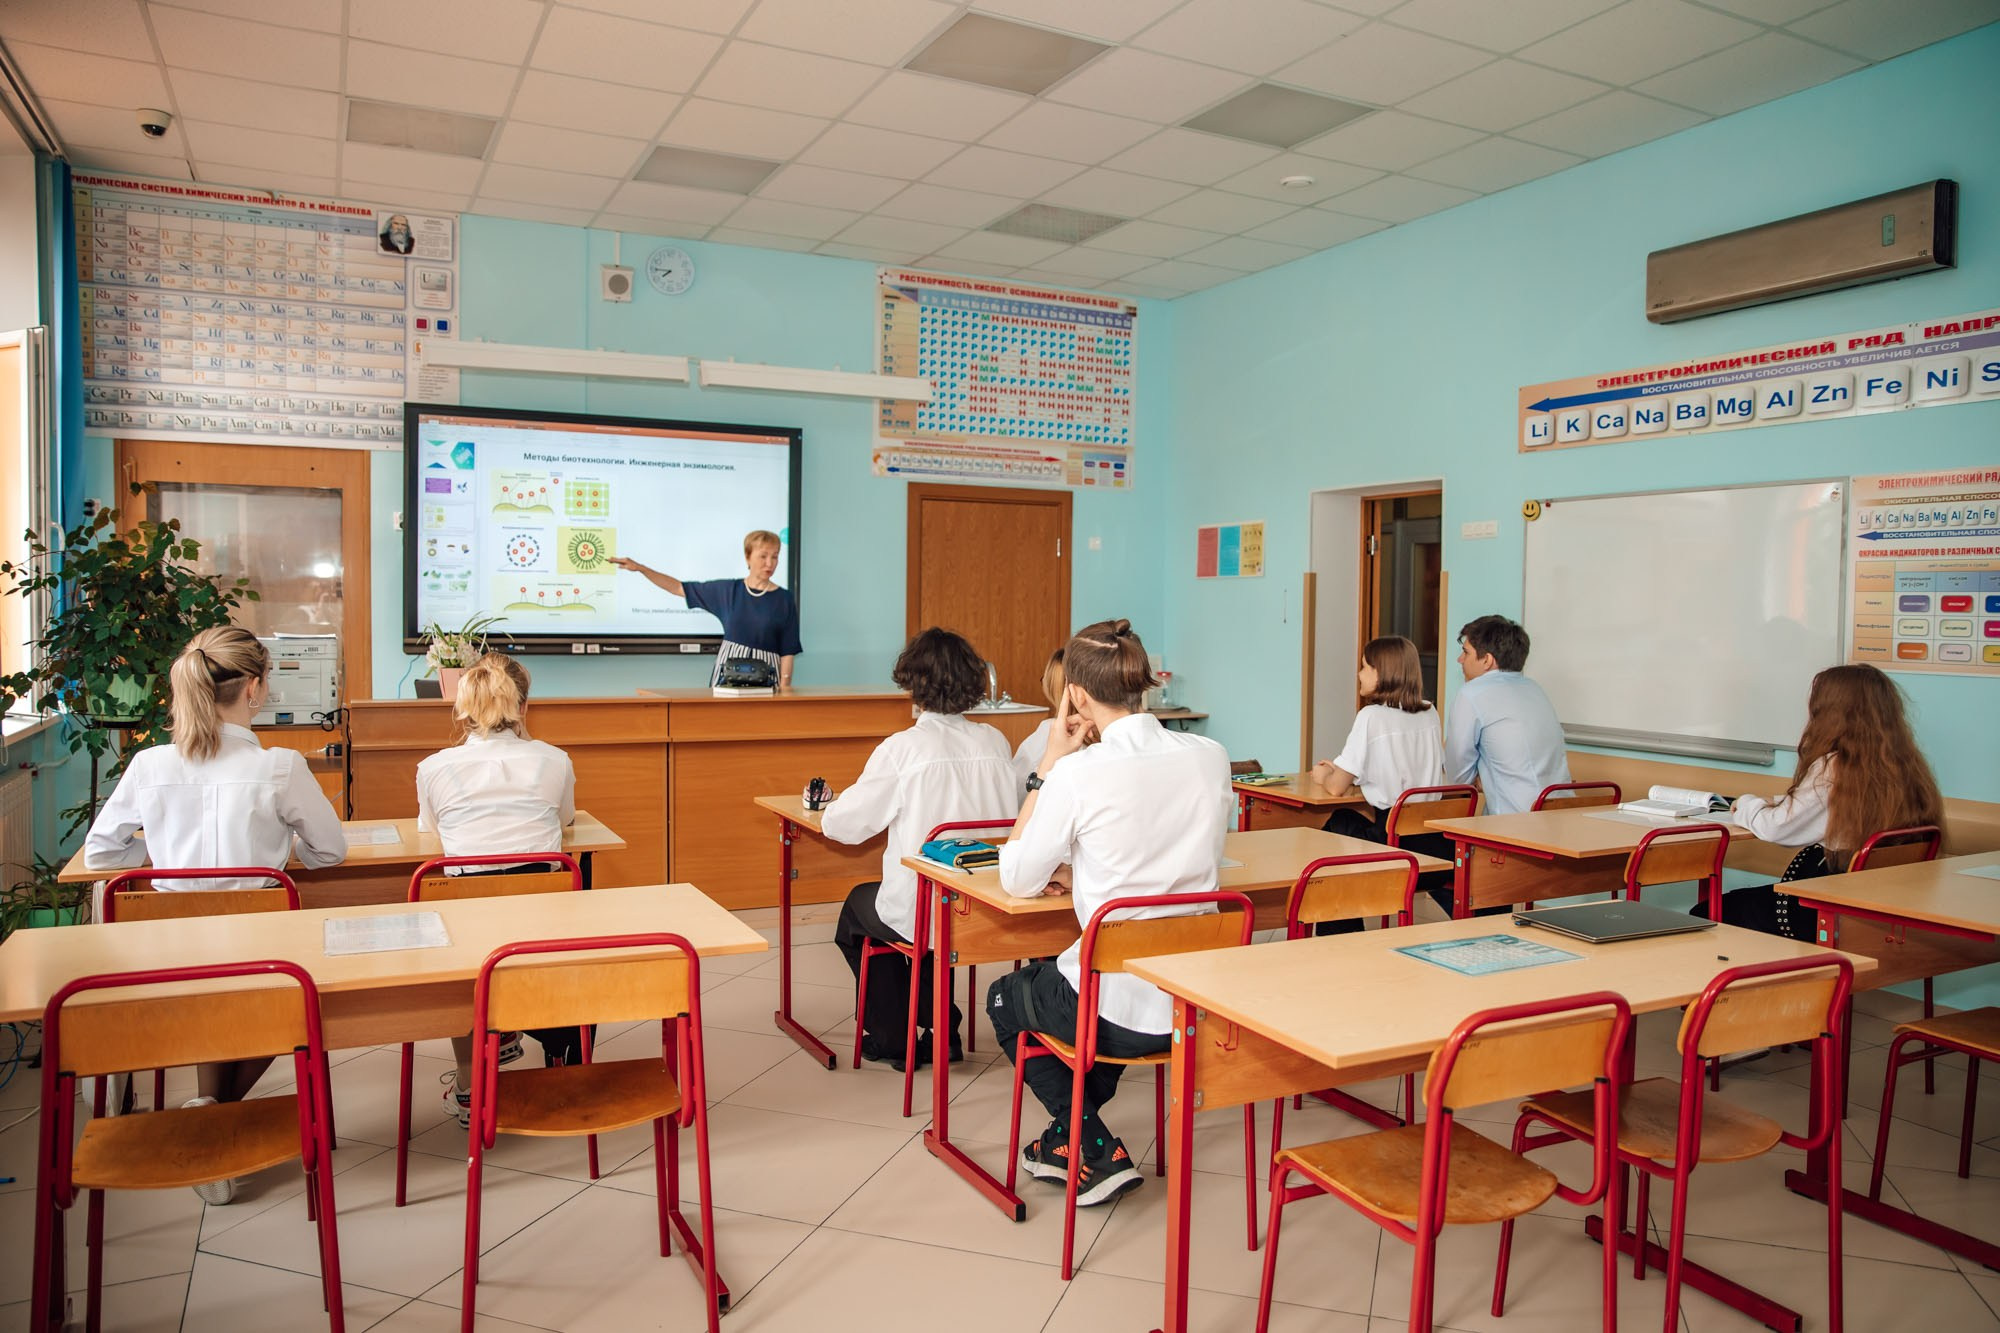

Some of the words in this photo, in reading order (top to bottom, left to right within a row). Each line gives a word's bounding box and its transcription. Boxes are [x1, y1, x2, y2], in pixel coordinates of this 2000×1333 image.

[141, 183, 184, 195] СИСТЕМА
[128, 241, 144, 253] Mg
[128, 257, 142, 266] Ca
[111, 269, 125, 279] Cu
[900, 274, 972, 288] РАСТВОРИМОСТЬ
[95, 289, 110, 299] Rb
[144, 338, 158, 349] Hg
[1597, 341, 1837, 389] ЭЛЕКТРОХИМИЧЕСКИЙ
[1848, 331, 1906, 350] РЯД
[1924, 315, 2000, 339] НАПР
[112, 366, 126, 377] Rg
[1642, 372, 1754, 395] ВОССТАНОВИТЕЛЬНАЯ
[1755, 360, 1841, 378] СПОСОБНОСТЬ
[120, 389, 132, 399] Pr
[148, 391, 163, 401] Nd
[175, 393, 193, 402] Pm
[254, 399, 270, 407] Gd
[306, 400, 319, 410] Dy
[1532, 423, 1547, 437] Li
[1567, 418, 1580, 433] K
[1597, 415, 1624, 429] Ca
[1636, 409, 1664, 425] Na
[1677, 405, 1706, 420] Ba
[1717, 398, 1752, 417] Mg
[1767, 390, 1793, 409] Al
[1812, 385, 1847, 403] Zn
[1867, 379, 1902, 397] Fe
[1927, 368, 1958, 389] Ni
[1982, 362, 2000, 381] S
[120, 413, 132, 422] Pa
[176, 415, 190, 426] Np
[202, 417, 216, 427] Pu
[524, 453, 559, 462] Методы
[562, 455, 627, 466] биотехнологии.
[629, 458, 680, 468] Инженерная
[683, 462, 736, 471] энзимология.
[1879, 473, 1981, 488] ЭЛЕКТРОХИМИЧЕСКИЙ
[1986, 472, 2000, 482] РЯ
[1885, 495, 1961, 504] ОКИСЛИТЕЛЬНАЯ
[1861, 515, 1867, 524] Li
[1876, 514, 1882, 523] K
[1888, 514, 1898, 523] Ca
[1903, 514, 1914, 522] Na
[1918, 513, 1929, 521] Ba
[1934, 512, 1946, 523] Mg
[1951, 511, 1960, 520] Al
[1967, 510, 1978, 519] Zn
[1984, 510, 1995, 518] Fe
[1883, 530, 1976, 538] ВОССТАНОВИТЕЛЬНАЯ
[1890, 548, 1938, 557] ИНДИКАТОРОВ
[1948, 547, 1993, 555] РАЗЛИЧНЫХ
